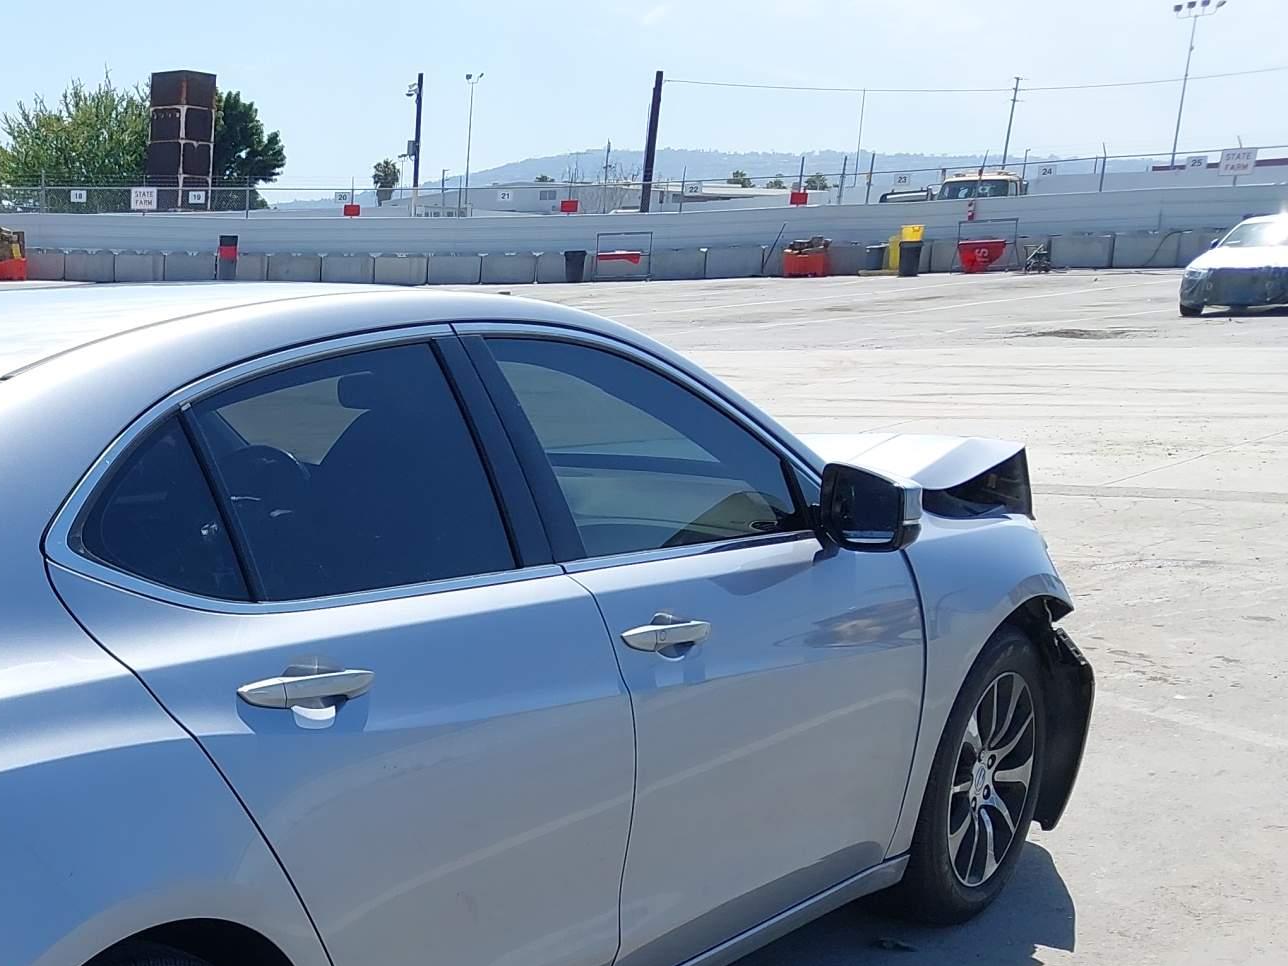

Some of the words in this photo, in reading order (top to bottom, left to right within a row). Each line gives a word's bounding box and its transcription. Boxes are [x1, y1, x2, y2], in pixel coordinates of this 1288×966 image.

[1226, 152, 1252, 160] STATE
[1191, 159, 1202, 167] 25
[1224, 163, 1249, 171] FARM
[1042, 168, 1052, 176] 24
